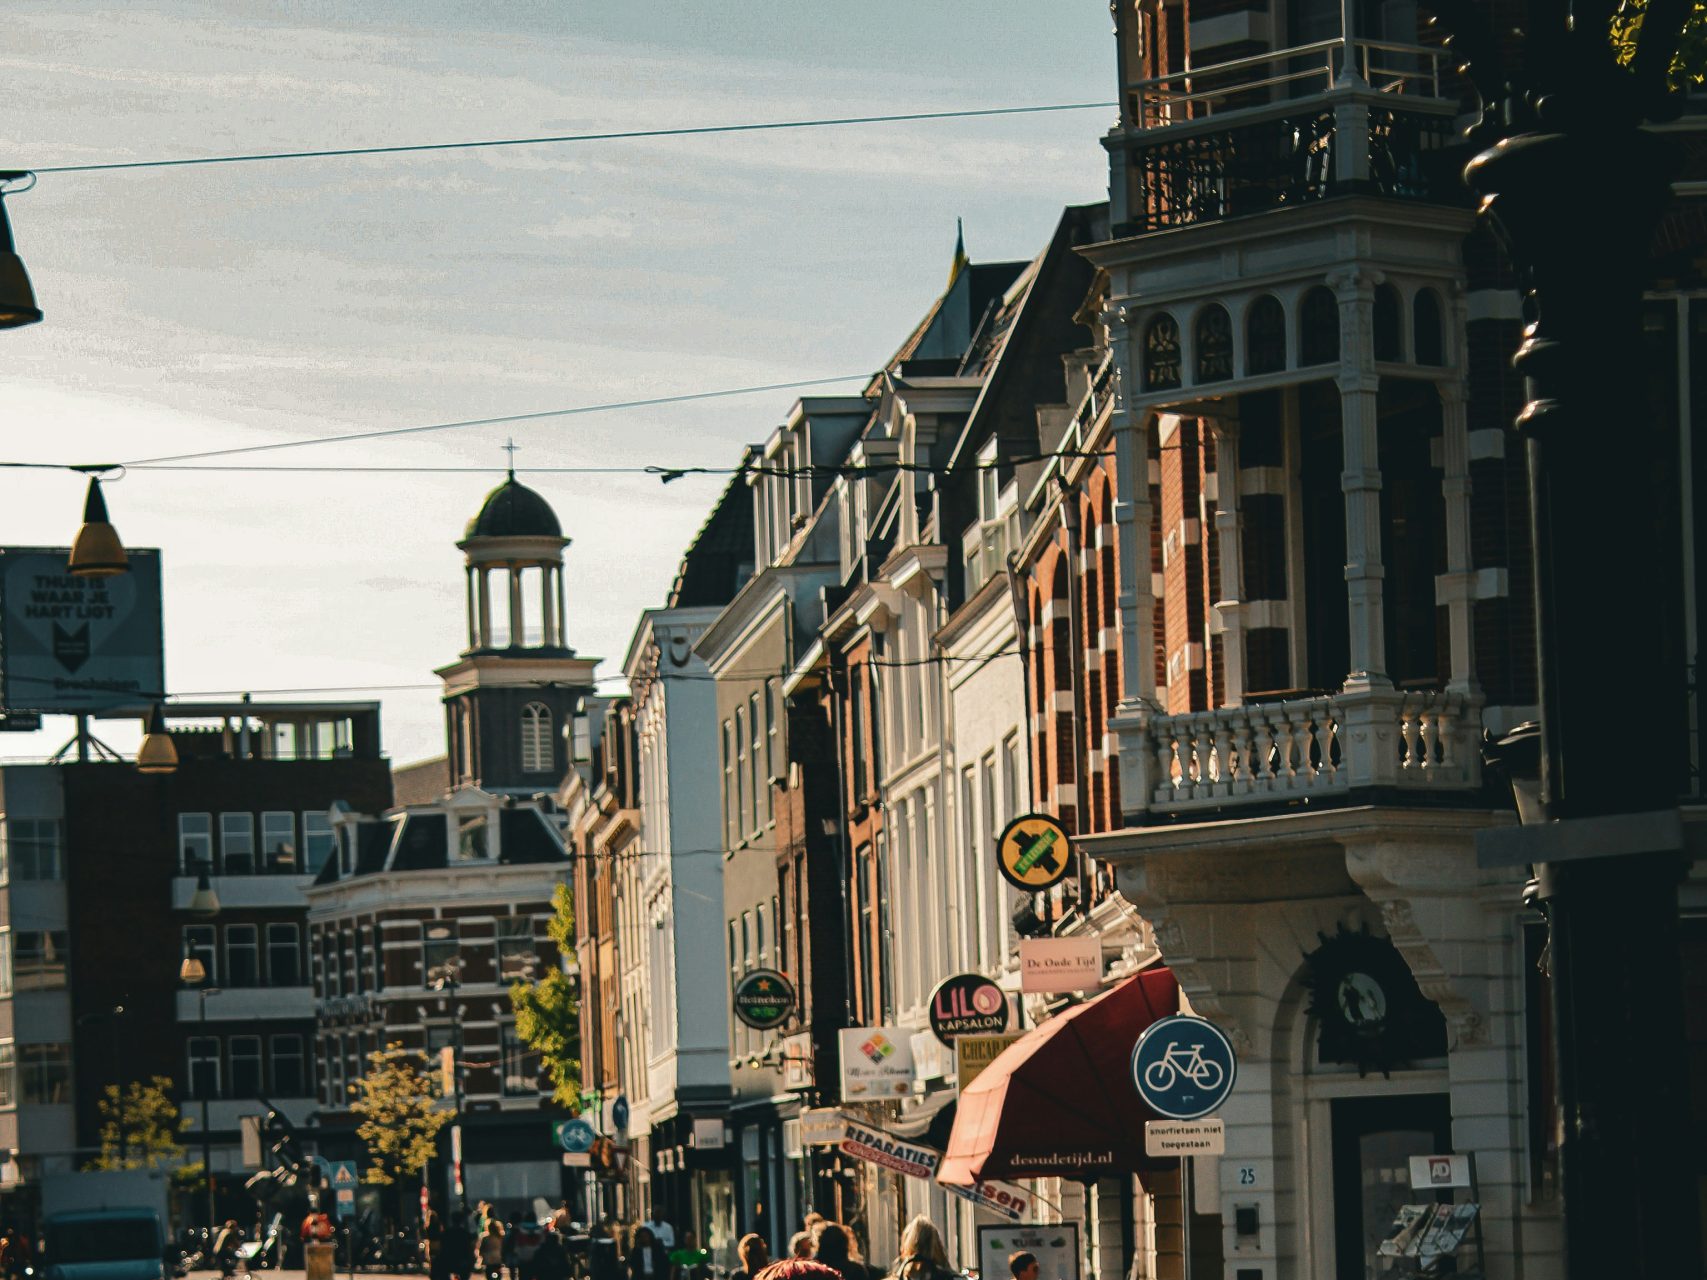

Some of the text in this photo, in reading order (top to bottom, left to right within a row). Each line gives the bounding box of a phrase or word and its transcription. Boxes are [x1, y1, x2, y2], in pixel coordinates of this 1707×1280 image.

[34, 575, 105, 588] THUIS IS
[31, 590, 109, 603] WAAR JE
[25, 605, 115, 618] HART LIGT
[1027, 956, 1096, 967] De Oude Tijd
[935, 984, 1003, 1019] LILO
[938, 1016, 1003, 1031] KAPSALON
[1150, 1126, 1222, 1135] snorfietsen niet
[845, 1125, 937, 1168] REPARATIES
[1161, 1141, 1211, 1150] toegestaan
[1010, 1152, 1113, 1167] deoudetijd.nl
[1241, 1168, 1255, 1184] 25
[1432, 1162, 1450, 1177] AD
[964, 1179, 1027, 1213] tsen
